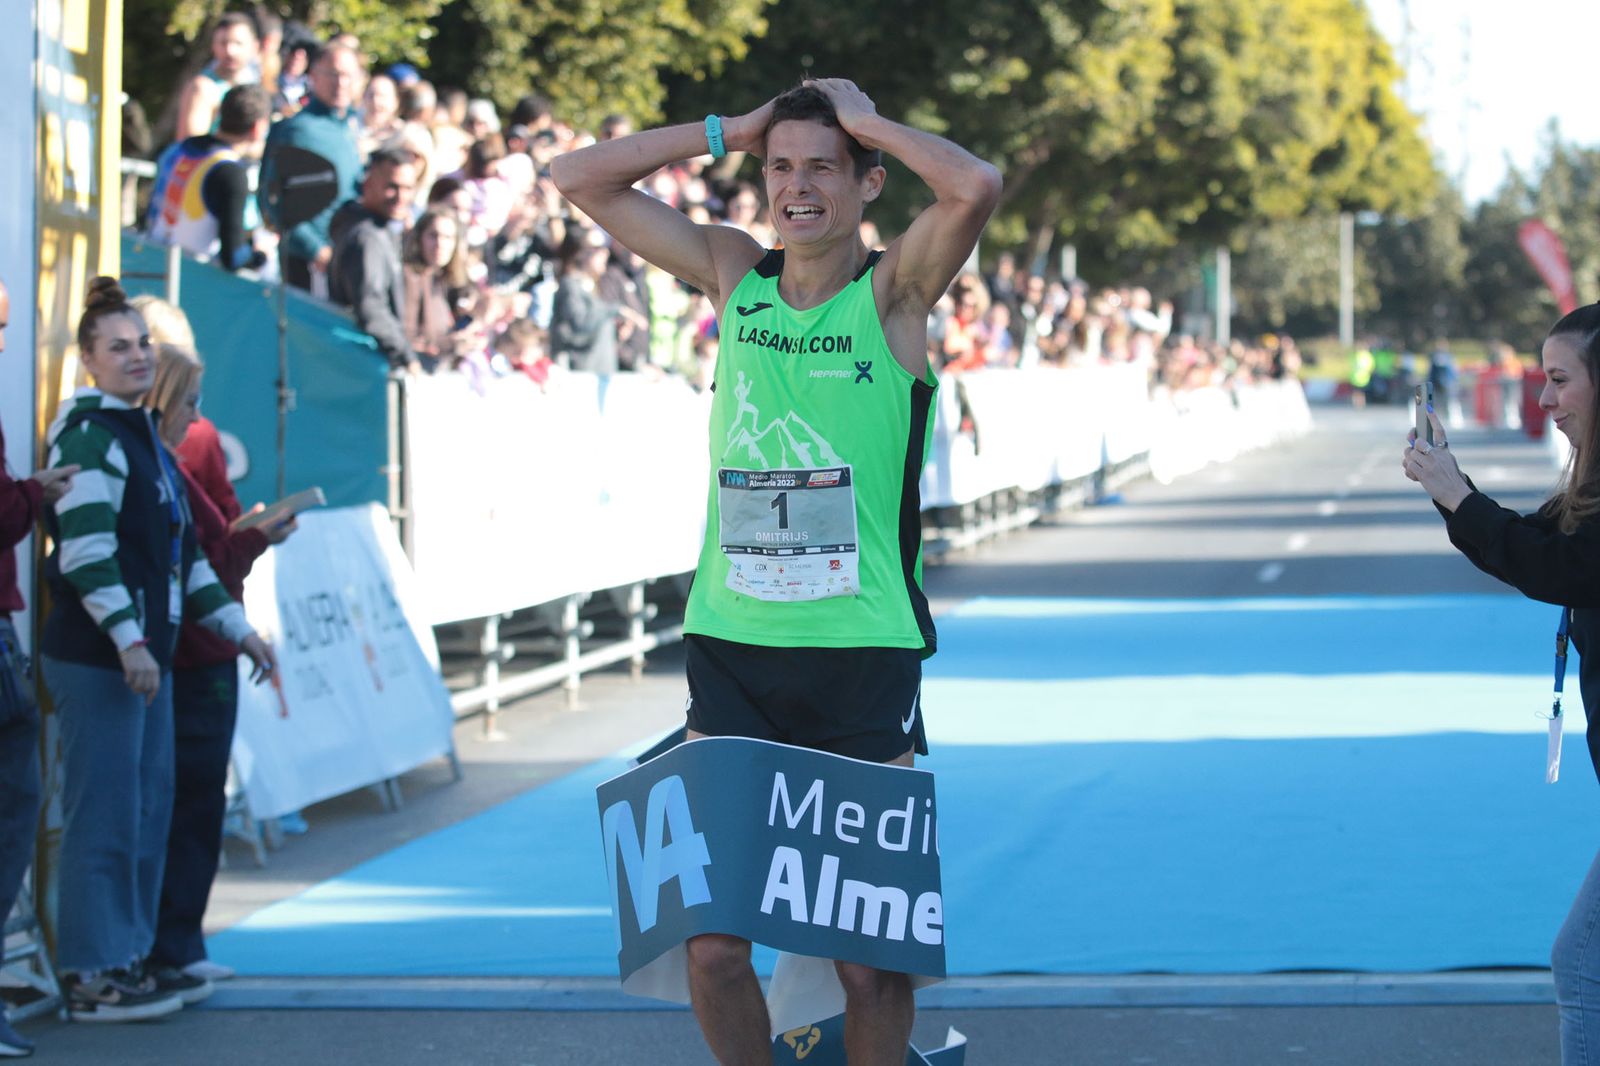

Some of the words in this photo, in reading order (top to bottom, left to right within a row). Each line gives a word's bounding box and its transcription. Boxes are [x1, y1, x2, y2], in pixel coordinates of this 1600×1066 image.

[737, 325, 853, 354] LASANSI.COM
[748, 473, 769, 481] Medio
[776, 479, 796, 487] 2022
[770, 491, 789, 530] 1
[767, 771, 941, 856] Medi
